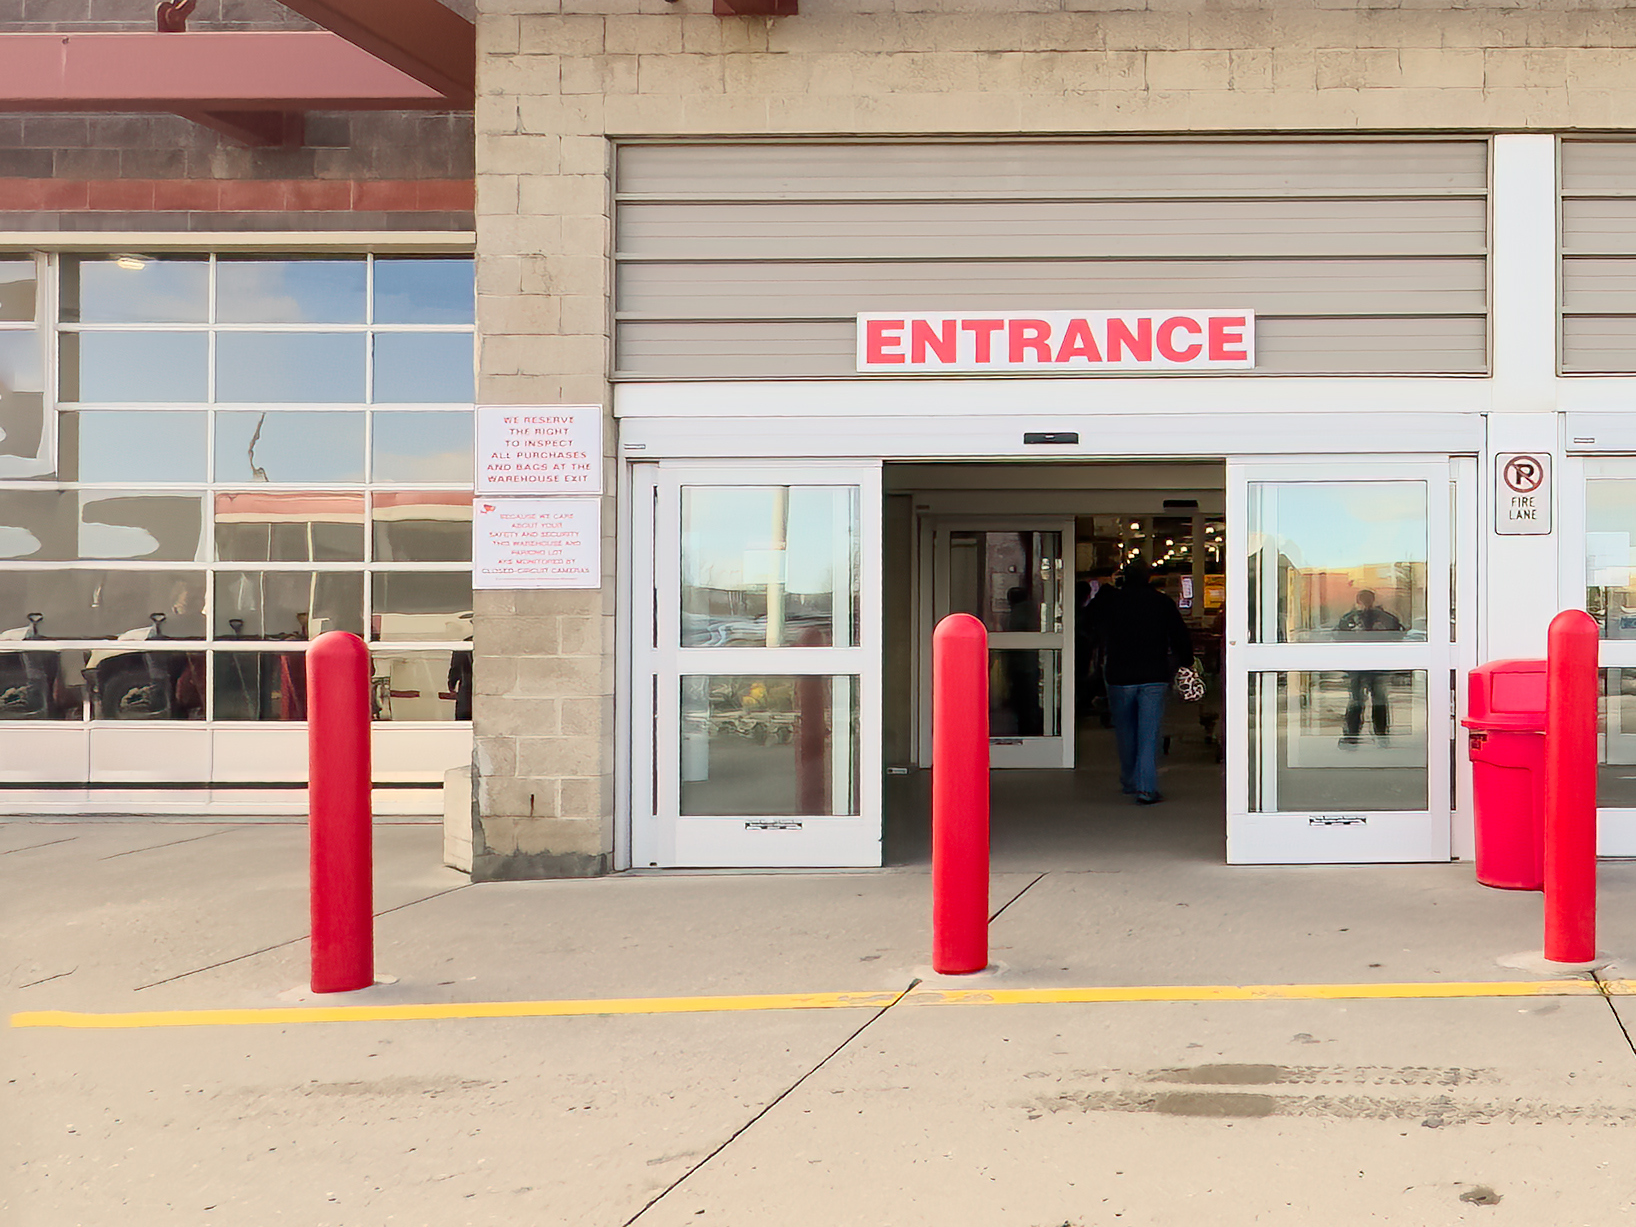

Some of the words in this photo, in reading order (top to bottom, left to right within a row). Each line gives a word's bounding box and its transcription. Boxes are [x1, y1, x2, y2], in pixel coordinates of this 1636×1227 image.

[866, 317, 1248, 364] ENTRANCE
[503, 416, 519, 424] WE
[523, 416, 574, 424] RESERVE
[509, 428, 530, 436] THE
[534, 428, 569, 436] RIGHT
[505, 439, 520, 448] TO
[524, 439, 573, 448] INSPECT
[491, 451, 511, 460] ALL
[516, 451, 587, 460] PURCHASES
[486, 463, 512, 471] AND
[515, 463, 548, 471] BAGS
[552, 463, 566, 471] AT
[571, 463, 591, 471] THE
[487, 474, 559, 483] WAREHOUSE
[564, 474, 588, 483] EXIT
[1511, 496, 1536, 508] FIRE
[1509, 509, 1537, 520] LANE
